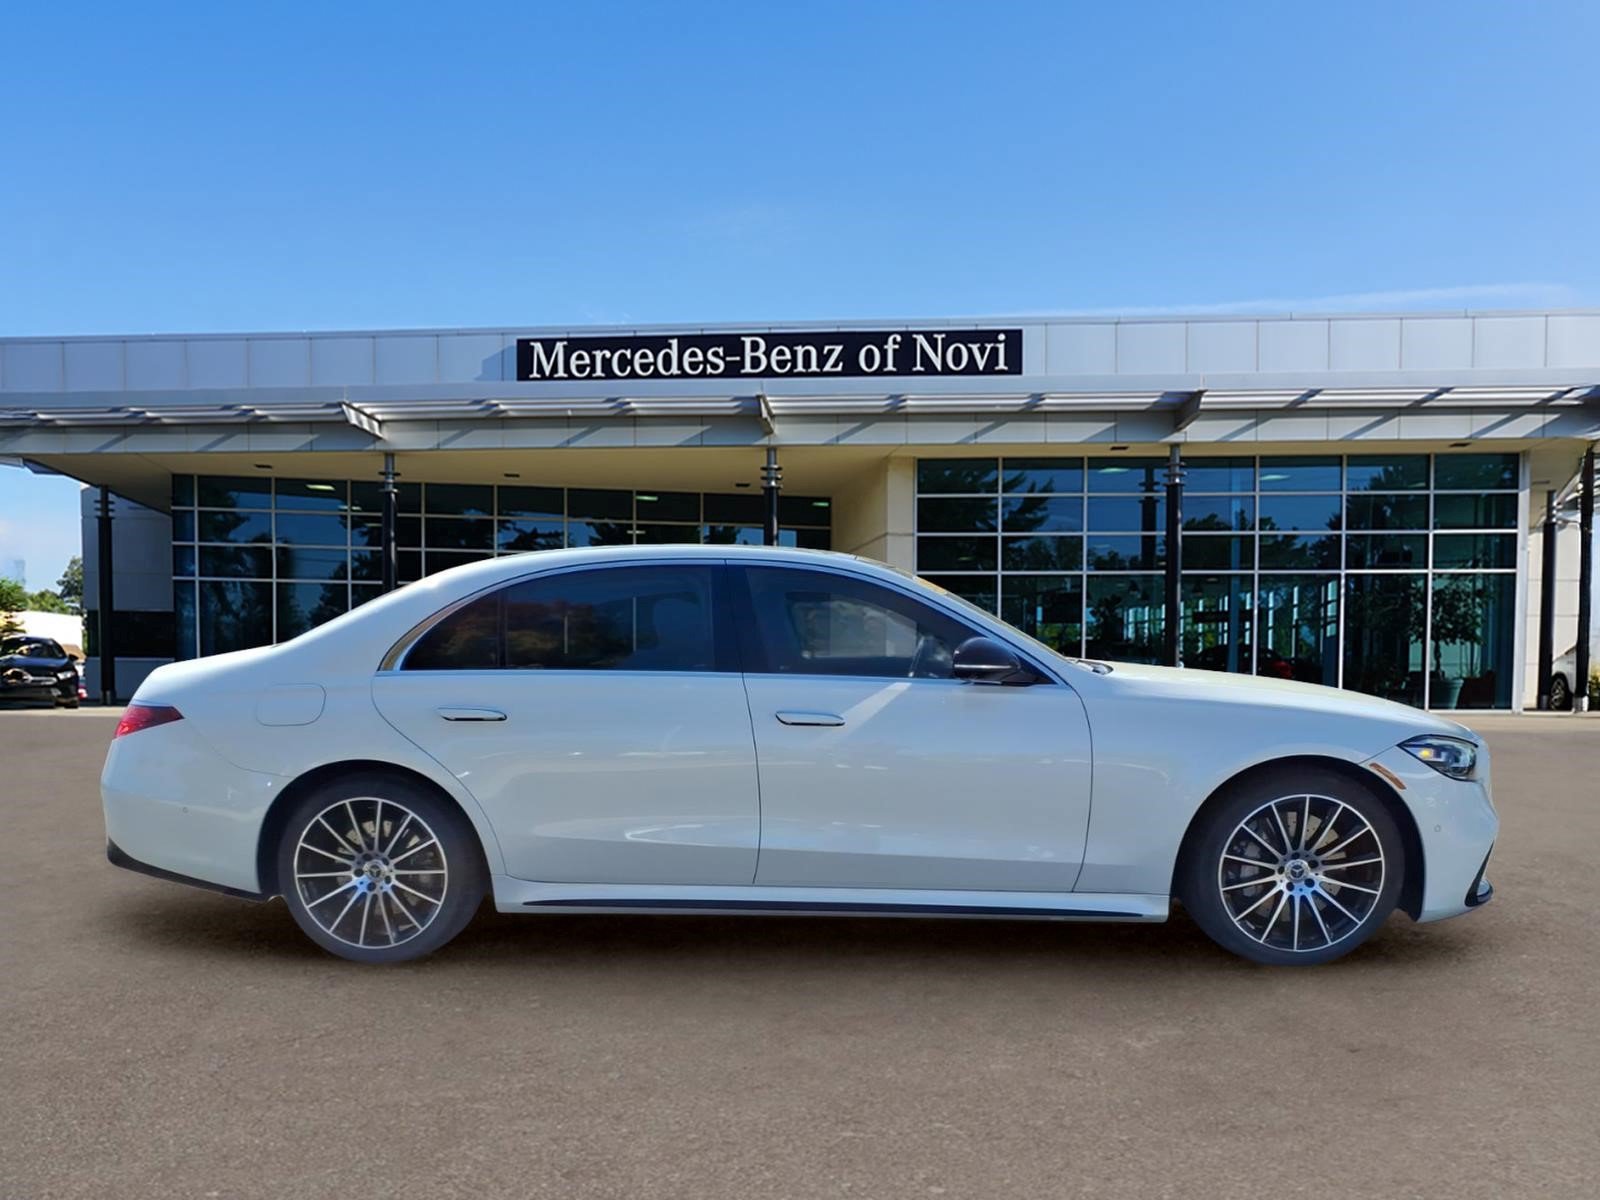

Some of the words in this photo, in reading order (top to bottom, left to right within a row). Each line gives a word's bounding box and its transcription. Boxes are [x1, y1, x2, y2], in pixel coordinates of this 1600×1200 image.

[529, 336, 844, 379] Mercedes-Benz
[858, 333, 902, 373] of
[912, 333, 1009, 372] Novi
